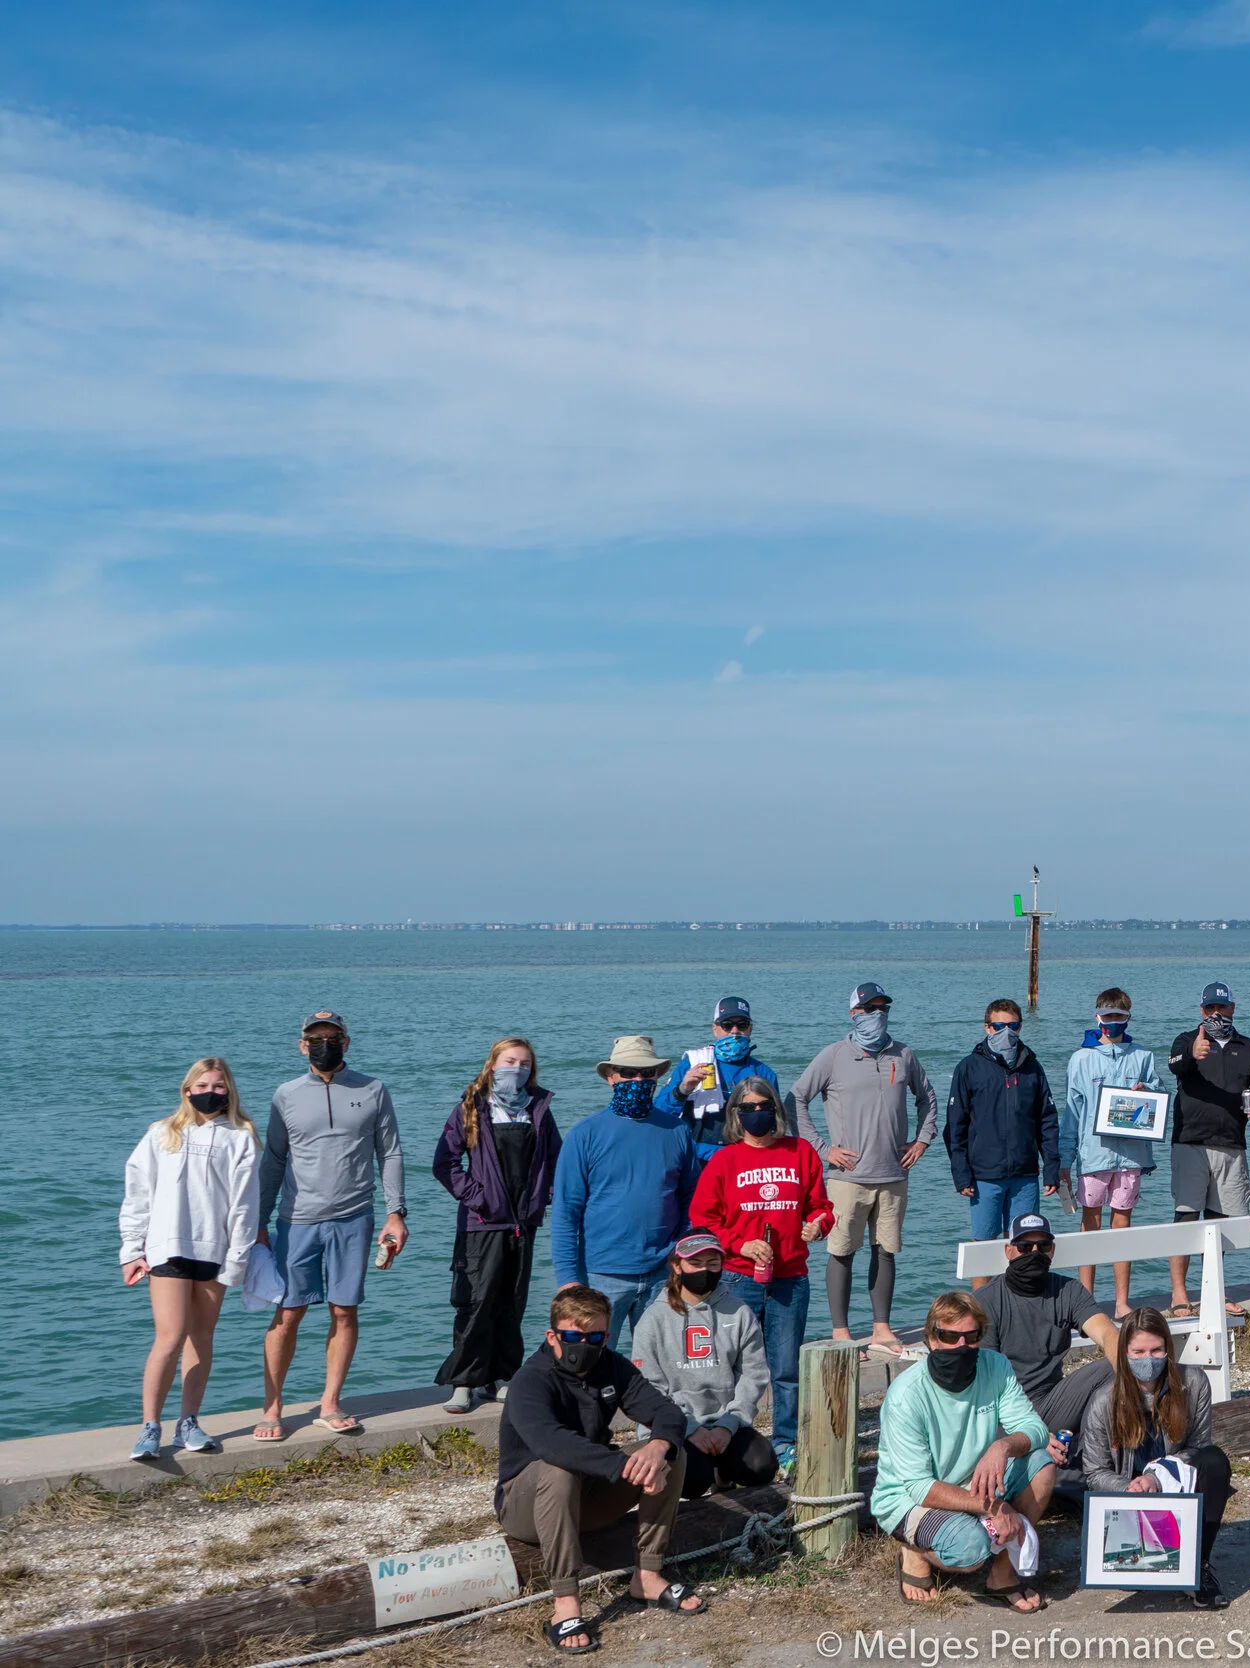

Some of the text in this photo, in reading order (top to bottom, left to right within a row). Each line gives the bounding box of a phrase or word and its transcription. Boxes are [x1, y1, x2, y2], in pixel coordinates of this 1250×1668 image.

[737, 1167, 800, 1188] CORNELL
[740, 1200, 798, 1212] UNIVERSITY
[685, 1325, 711, 1359] C
[378, 1544, 506, 1579] No Parking
[391, 1591, 418, 1605] Tow
[421, 1583, 457, 1599] Away
